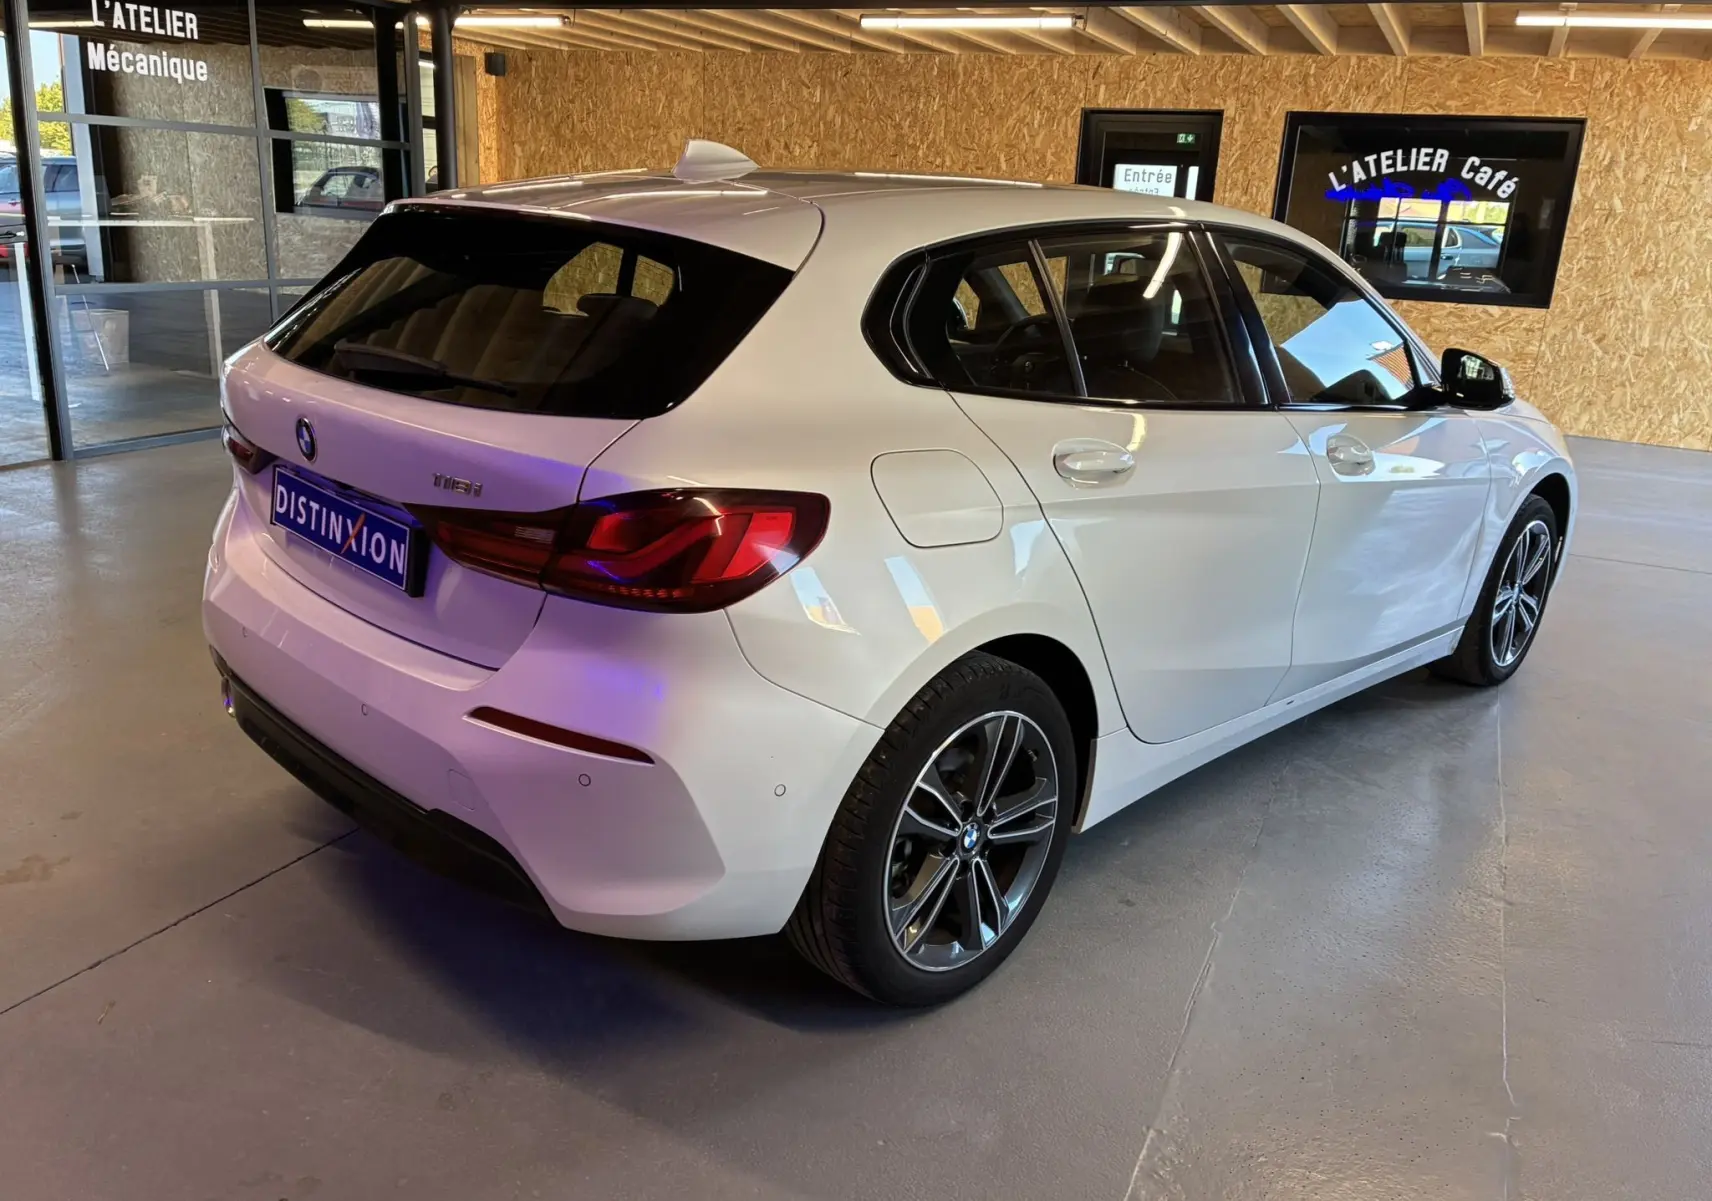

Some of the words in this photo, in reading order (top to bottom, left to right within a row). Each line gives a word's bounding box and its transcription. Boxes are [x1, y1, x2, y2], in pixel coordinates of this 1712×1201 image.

[91, 0, 199, 40] L'ATELIER
[87, 42, 208, 84] Mécanique
[1124, 168, 1172, 184] Entrée
[1328, 147, 1450, 192] L'ATELIER
[1460, 156, 1519, 198] Café
[432, 472, 483, 498] 118i
[275, 484, 405, 575] DISTINXION
